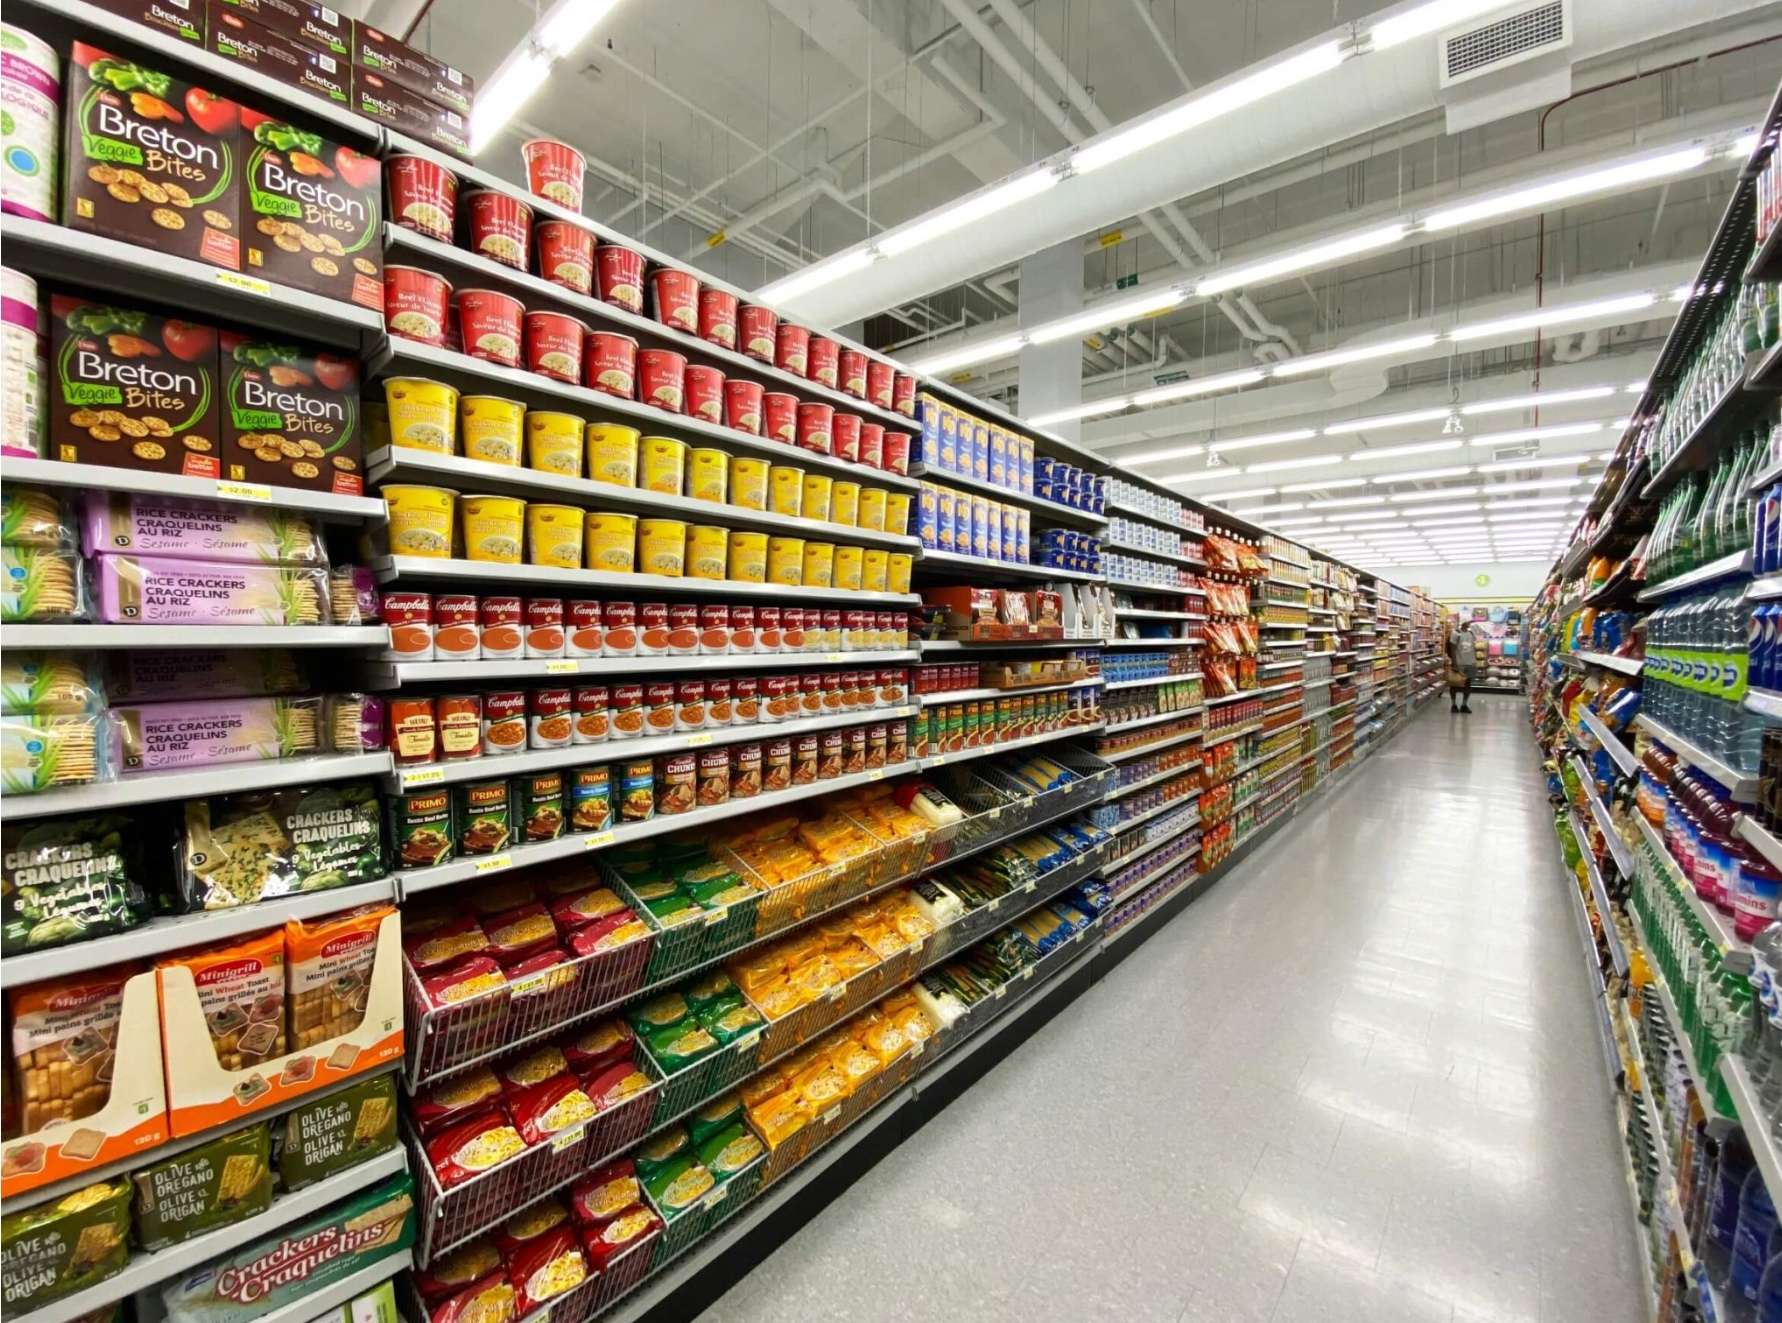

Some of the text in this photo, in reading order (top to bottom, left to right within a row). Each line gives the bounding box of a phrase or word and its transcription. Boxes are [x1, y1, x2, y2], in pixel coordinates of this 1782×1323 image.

[151, 4, 194, 31] Breton
[218, 32, 258, 57] Breton
[306, 21, 342, 46] Breton
[363, 45, 397, 69] Breton
[306, 70, 342, 93] Breton
[362, 92, 396, 115] Breton
[100, 104, 219, 169] Breton
[89, 138, 206, 182] Veggie Bites
[265, 163, 364, 221] Breton
[256, 194, 355, 232] Veggie Bites
[79, 351, 196, 394] Breton
[69, 385, 185, 410] Veggie Bites
[245, 381, 343, 420] Breton
[237, 412, 334, 434] Veggie Bites
[136, 508, 238, 524] RICE CRACKERS
[137, 519, 223, 532] CRAQUELINS
[137, 528, 183, 538] AU RIZ
[145, 577, 246, 590] RICE CRACKERS
[146, 587, 230, 599] CRAQUELINS
[146, 596, 190, 606] AU RIZ
[146, 724, 175, 735] RICE
[178, 719, 242, 732] CRACKERS
[146, 730, 228, 744] CRAQUELINS
[147, 742, 189, 752] AU RIZ
[411, 797, 446, 809] PRIMO
[472, 789, 505, 800] PRIMO
[286, 808, 353, 830] CRACKERS
[293, 821, 371, 844] CRAQUELINS
[326, 933, 374, 953] Minigrill
[200, 961, 257, 981] Minigrill
[306, 971, 325, 981] Mini
[302, 1105, 334, 1126] OLIVE
[303, 1111, 352, 1139] OREGANO
[304, 1132, 335, 1154] OLIVE
[305, 1141, 344, 1166] ORIGAN
[154, 1163, 193, 1185] OLIVE
[157, 1169, 214, 1198] OREGANO
[159, 1191, 196, 1212] OLIVE
[161, 1200, 206, 1223] ORIGAN
[217, 1225, 337, 1296] Crackers
[239, 1222, 384, 1303] Craquelins
[2, 1262, 46, 1288] OLIVE
[5, 1267, 56, 1302] ORIGAN
